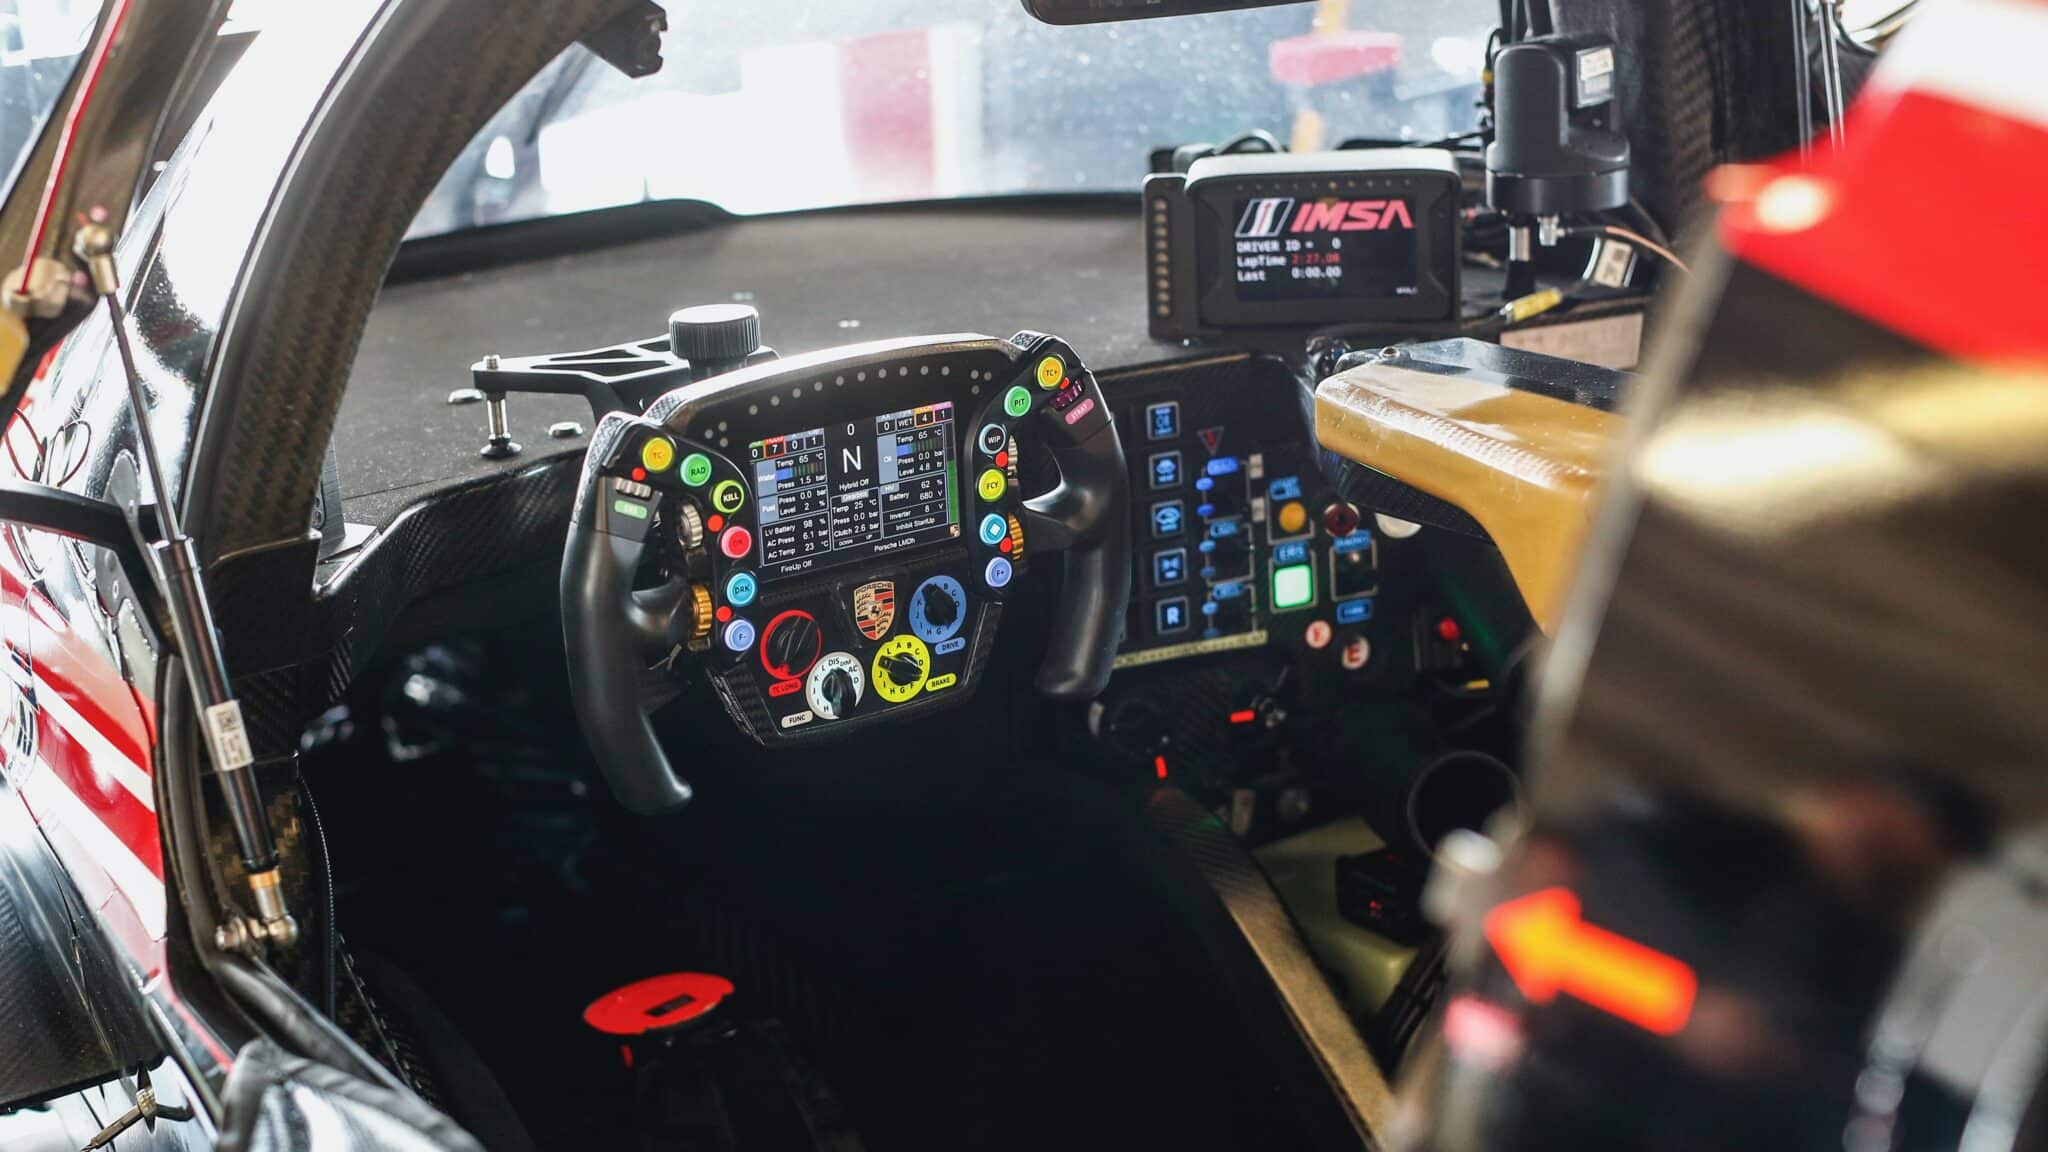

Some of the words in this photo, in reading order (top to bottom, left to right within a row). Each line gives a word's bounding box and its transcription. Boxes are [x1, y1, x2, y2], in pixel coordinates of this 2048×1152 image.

[1290, 200, 1415, 232] IMSA
[1236, 240, 1280, 252] DRIVER
[1286, 239, 1300, 252] ID
[1237, 254, 1286, 268] LapTime
[1238, 270, 1266, 282] Last
[1014, 398, 1024, 406] PIT
[884, 422, 890, 430] 0
[898, 418, 912, 426] WET
[922, 414, 928, 422] 4
[847, 424, 854, 436] 0
[919, 431, 928, 440] 65
[988, 436, 1000, 444] WIP
[752, 448, 758, 458] 0
[772, 444, 778, 454] 7
[792, 440, 798, 450] 0
[799, 455, 808, 464] 65
[842, 445, 861, 473] N
[919, 452, 930, 460] 0.0
[691, 467, 706, 476] RAD
[899, 468, 914, 476] Level
[920, 463, 930, 472] 4.8
[800, 476, 811, 484] 1.5
[921, 480, 930, 488] 62
[840, 480, 858, 492] Hybrid
[986, 481, 998, 490] FCY
[723, 492, 740, 502] KILL
[800, 491, 812, 500] 0.0
[890, 492, 910, 501] Battery
[920, 492, 933, 500] 680
[854, 501, 864, 510] 25
[780, 506, 796, 515] Level
[890, 510, 911, 520] Inverter
[854, 512, 864, 521] 0.0
[765, 528, 774, 536] LV
[775, 525, 795, 534] Battery
[803, 520, 813, 528] 98
[834, 529, 852, 538] Clutch
[854, 524, 866, 533] 2.6
[803, 531, 814, 540] 6.1
[805, 542, 814, 551] 23
[874, 541, 897, 552] Porsche
[735, 586, 750, 594] DRK
[856, 582, 892, 596] PORSCHE
[1166, 606, 1180, 624] R
[942, 641, 958, 650] DRIVE
[828, 658, 840, 666] DIS
[932, 678, 950, 688] BRAKE
[789, 714, 806, 724] FUNC
